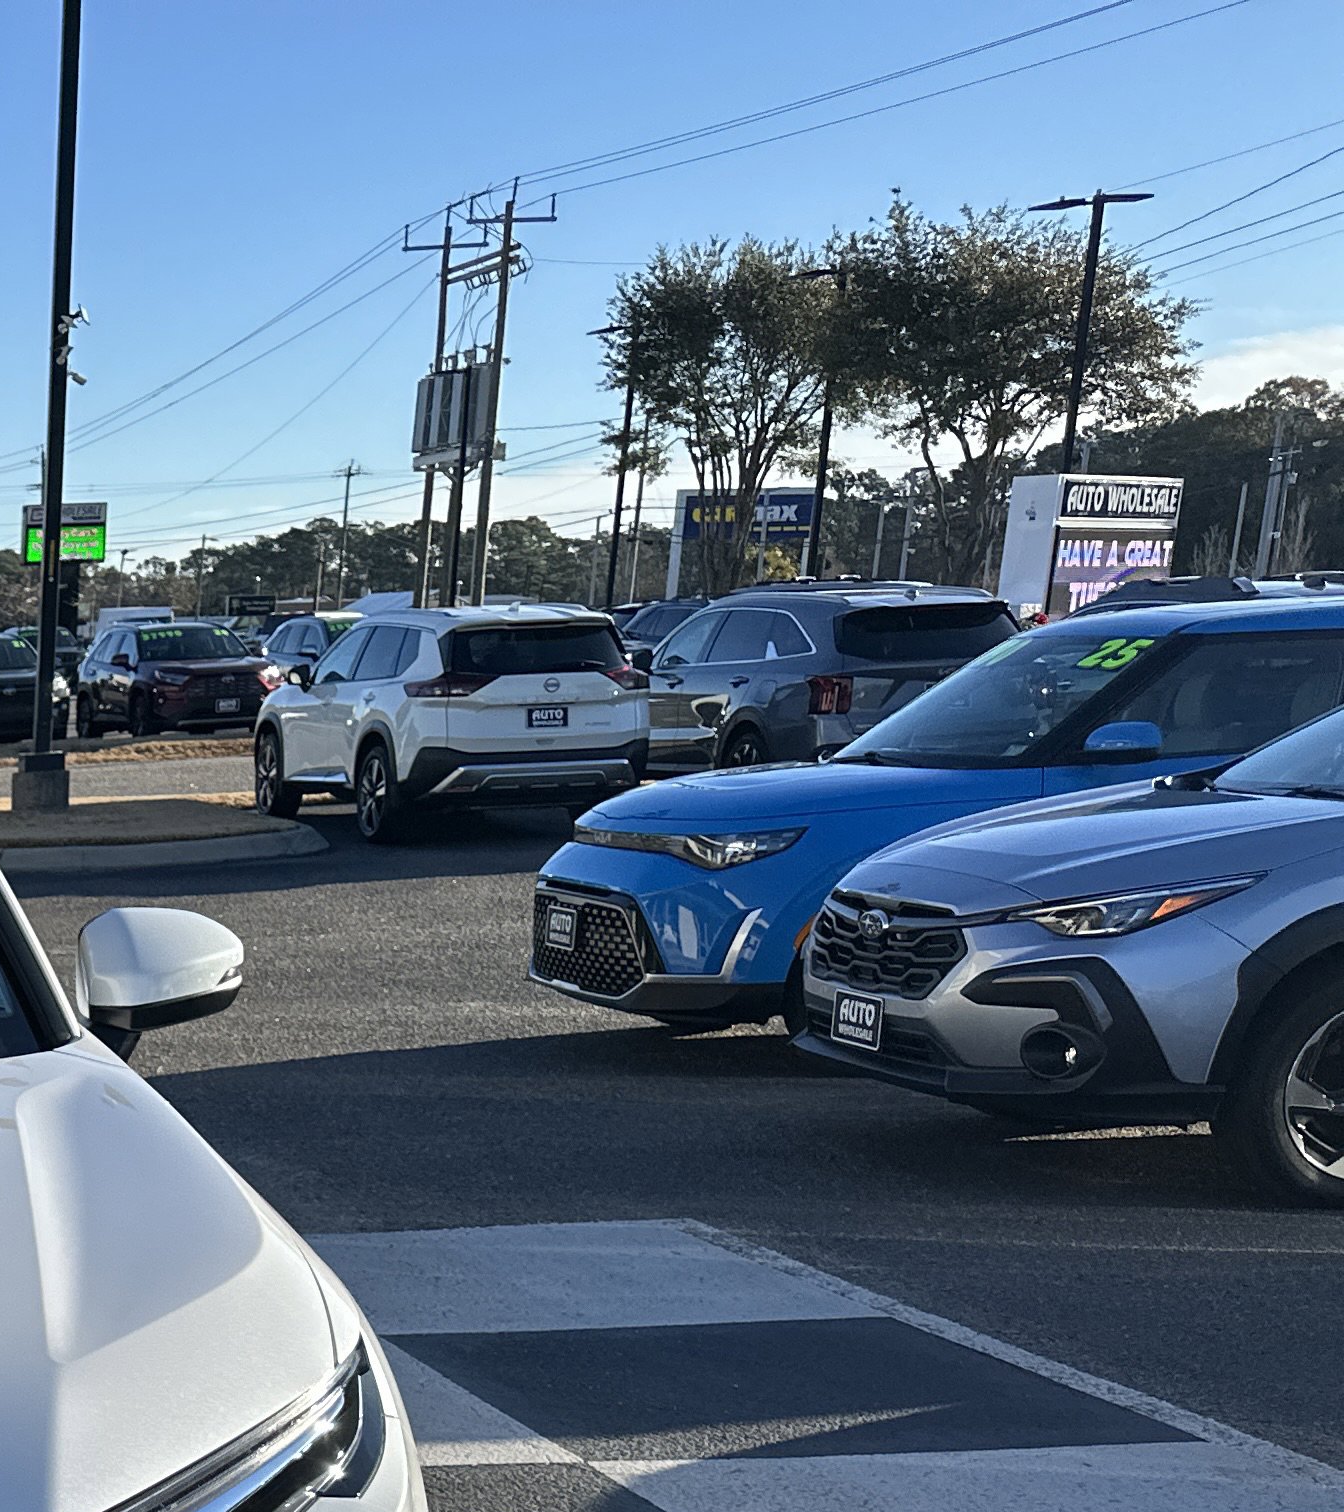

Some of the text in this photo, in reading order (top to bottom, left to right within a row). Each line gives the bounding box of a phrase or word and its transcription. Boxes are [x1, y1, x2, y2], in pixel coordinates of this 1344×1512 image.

[1066, 484, 1179, 514] AUTO WHOLESALE
[1058, 540, 1174, 567] HAVE A GREAT
[1076, 638, 1155, 669] 25
[532, 709, 564, 720] AUTO
[549, 912, 572, 933] AUTO
[839, 998, 875, 1027] AUTO
[838, 1023, 873, 1042] WHOLESALE
